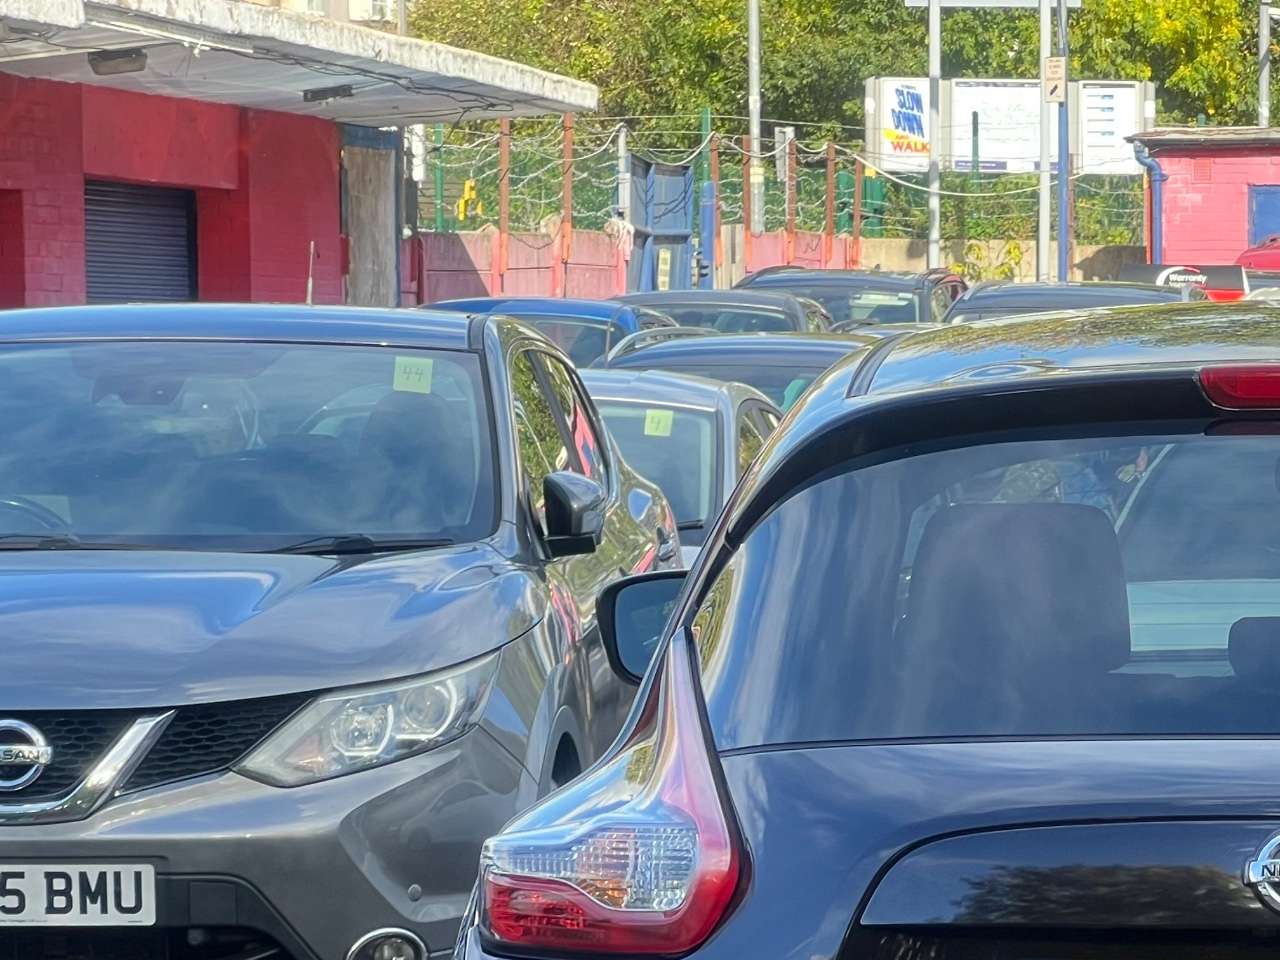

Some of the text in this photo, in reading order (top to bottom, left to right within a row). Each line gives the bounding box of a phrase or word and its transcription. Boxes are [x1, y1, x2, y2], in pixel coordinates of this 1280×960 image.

[891, 108, 925, 138] DOWN
[891, 141, 929, 153] WALK
[1169, 273, 1207, 285] Warranty
[44, 871, 143, 915] BMU
